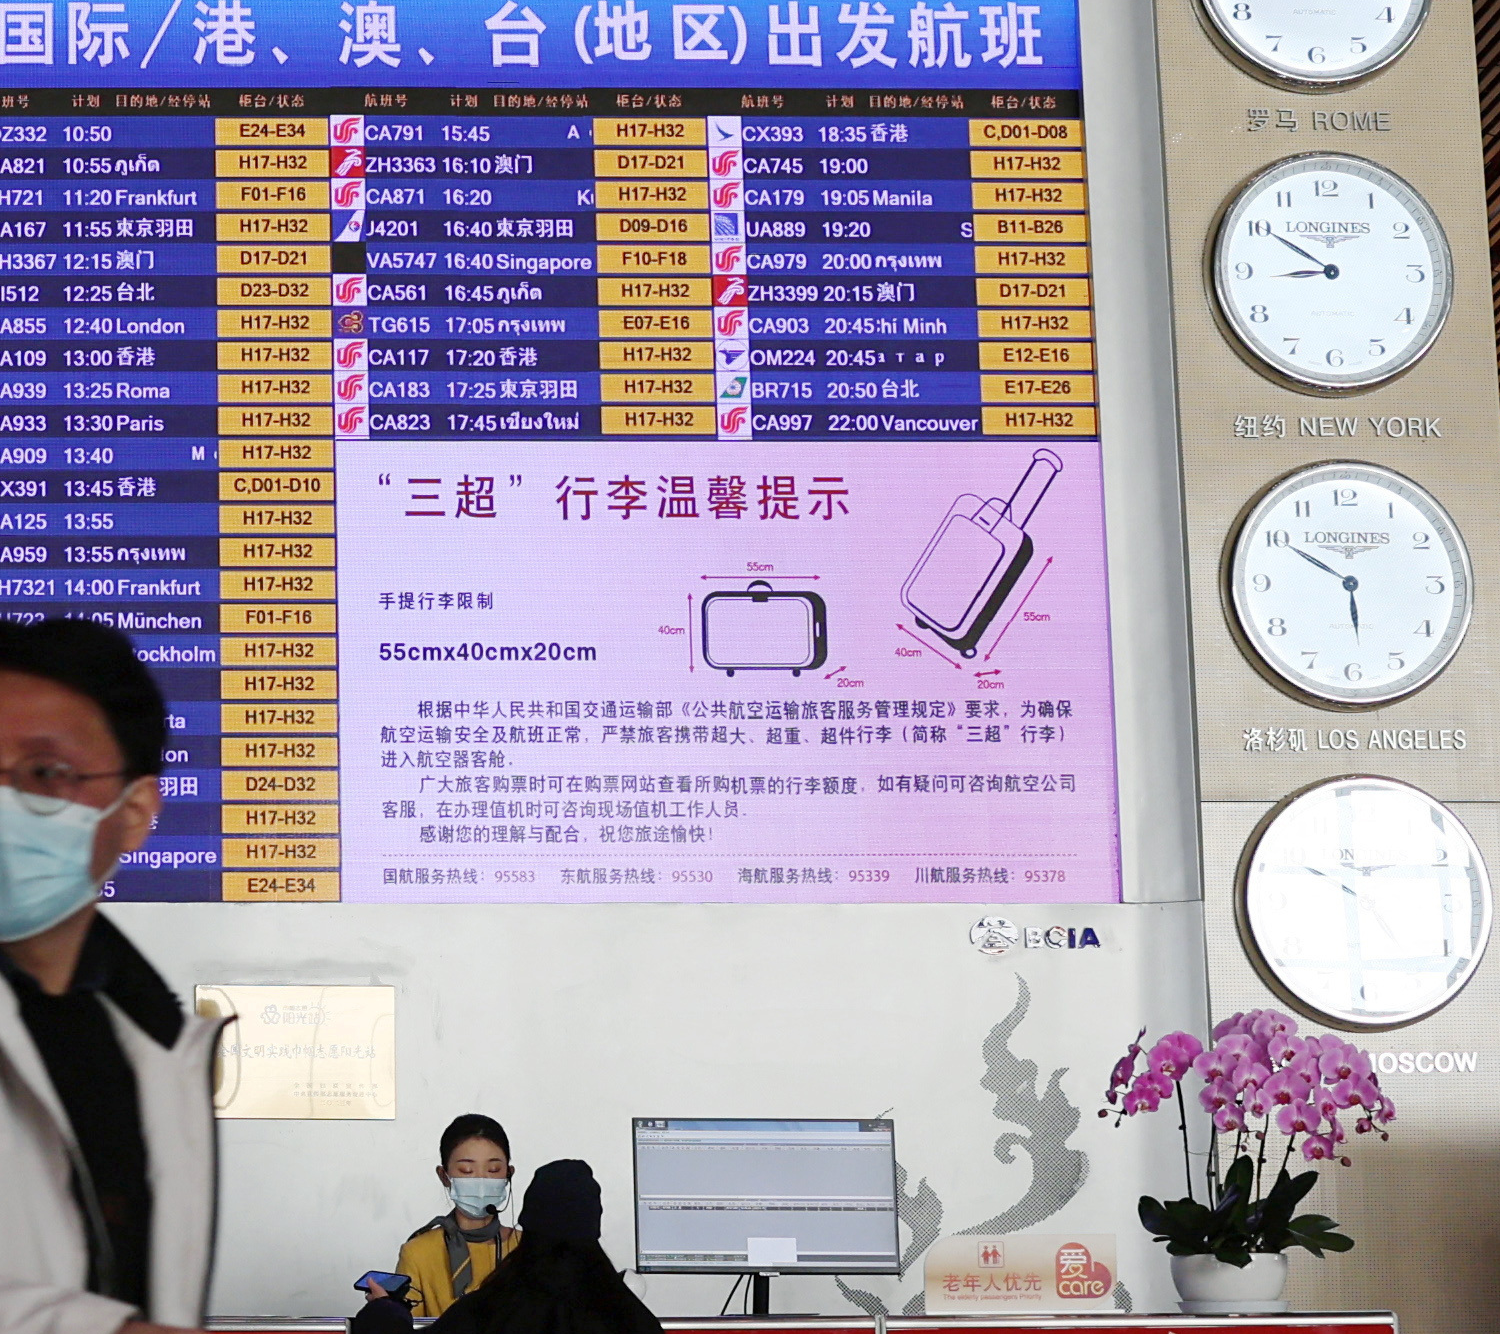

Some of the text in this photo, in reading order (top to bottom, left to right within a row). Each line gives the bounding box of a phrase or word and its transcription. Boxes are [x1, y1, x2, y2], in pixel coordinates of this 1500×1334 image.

[1247, 109, 1390, 132] 罗马 ROME
[742, 123, 1067, 143] CX393 18:35 香港 C,D01-D08
[63, 158, 110, 173] 10:55
[240, 155, 307, 170] H17-H32
[63, 190, 112, 205] 11:20
[116, 189, 197, 206] Frankfurt
[241, 187, 305, 202] F01-F16
[745, 188, 1062, 206] CA179 19:05 Manila H17-H32
[367, 251, 686, 274] VA5747 16:40 Singapore F10-F18
[368, 317, 430, 333] TG615
[446, 317, 495, 332] 17:05
[624, 316, 689, 331] E07-E16
[753, 412, 1073, 431] CA997 22:00 Vancouver H17-H32
[1235, 416, 1441, 439] 纽约 NEW YORK
[555, 474, 848, 520] 行李温馨提示
[1304, 531, 1390, 545] LONGINES
[747, 561, 774, 572] 55cm
[379, 592, 494, 610] 手提行李限制
[658, 625, 685, 636] 40cm
[379, 642, 596, 662] 55cmx40cmx20cm
[1242, 728, 1467, 751] 洛杉矶 LOS ANGELES
[1025, 927, 1101, 950] BCIA
[1060, 1249, 1087, 1279] 爱
[943, 1273, 1042, 1291] 老年人优先
[1059, 1280, 1104, 1295] care
